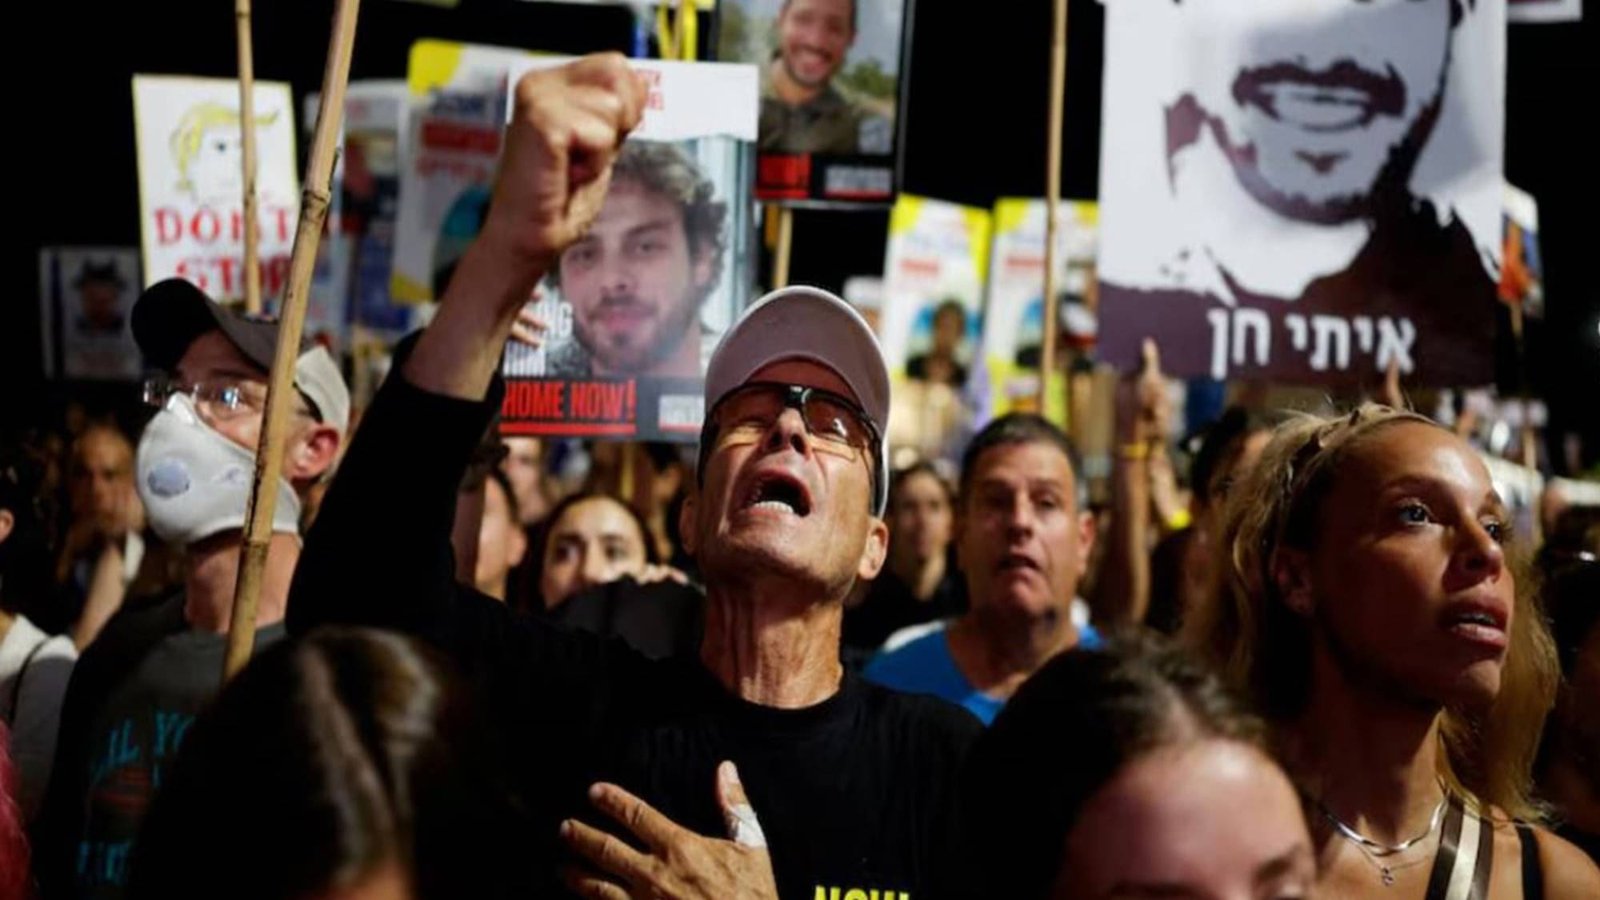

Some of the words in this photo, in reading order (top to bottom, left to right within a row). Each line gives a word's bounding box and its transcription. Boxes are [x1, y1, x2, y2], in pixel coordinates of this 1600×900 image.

[1206, 307, 1271, 381] חן
[1284, 312, 1416, 375] איתי
[502, 380, 565, 418] HOME
[569, 377, 637, 423] NOW!
